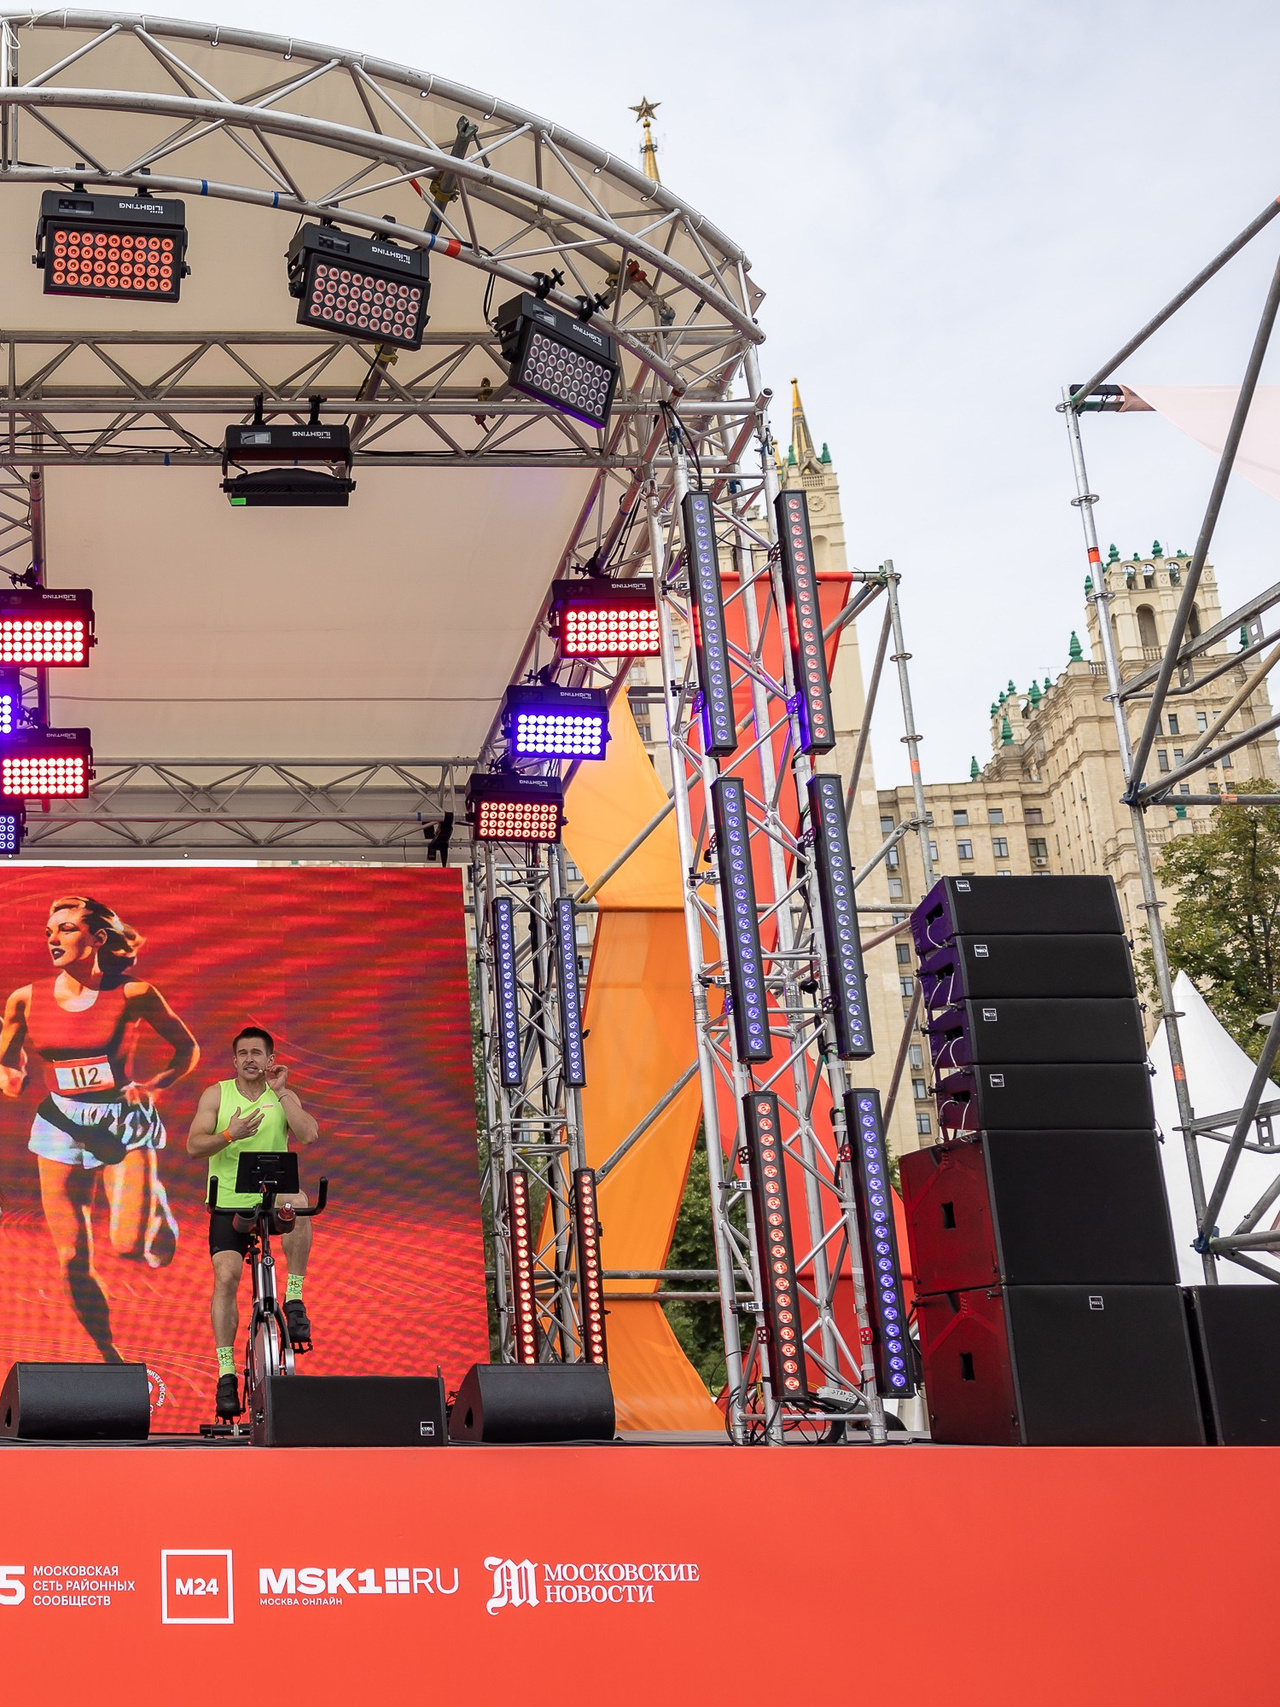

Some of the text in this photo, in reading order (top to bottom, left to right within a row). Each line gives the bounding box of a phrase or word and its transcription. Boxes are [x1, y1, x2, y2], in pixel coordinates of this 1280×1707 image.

[70, 1066, 102, 1089] 112
[33, 1565, 119, 1577] МОСКОВСКАЯ
[543, 1563, 700, 1582] МОСКОВСКИЕ
[33, 1578, 136, 1592] СЕТЬ РАЙОННЫХ
[176, 1578, 220, 1596] М24
[259, 1596, 343, 1606] МОСКВА ОНЛАЙН
[544, 1584, 655, 1603] НОВОСТИ
[33, 1595, 111, 1609] СООБЩЕСТВ
